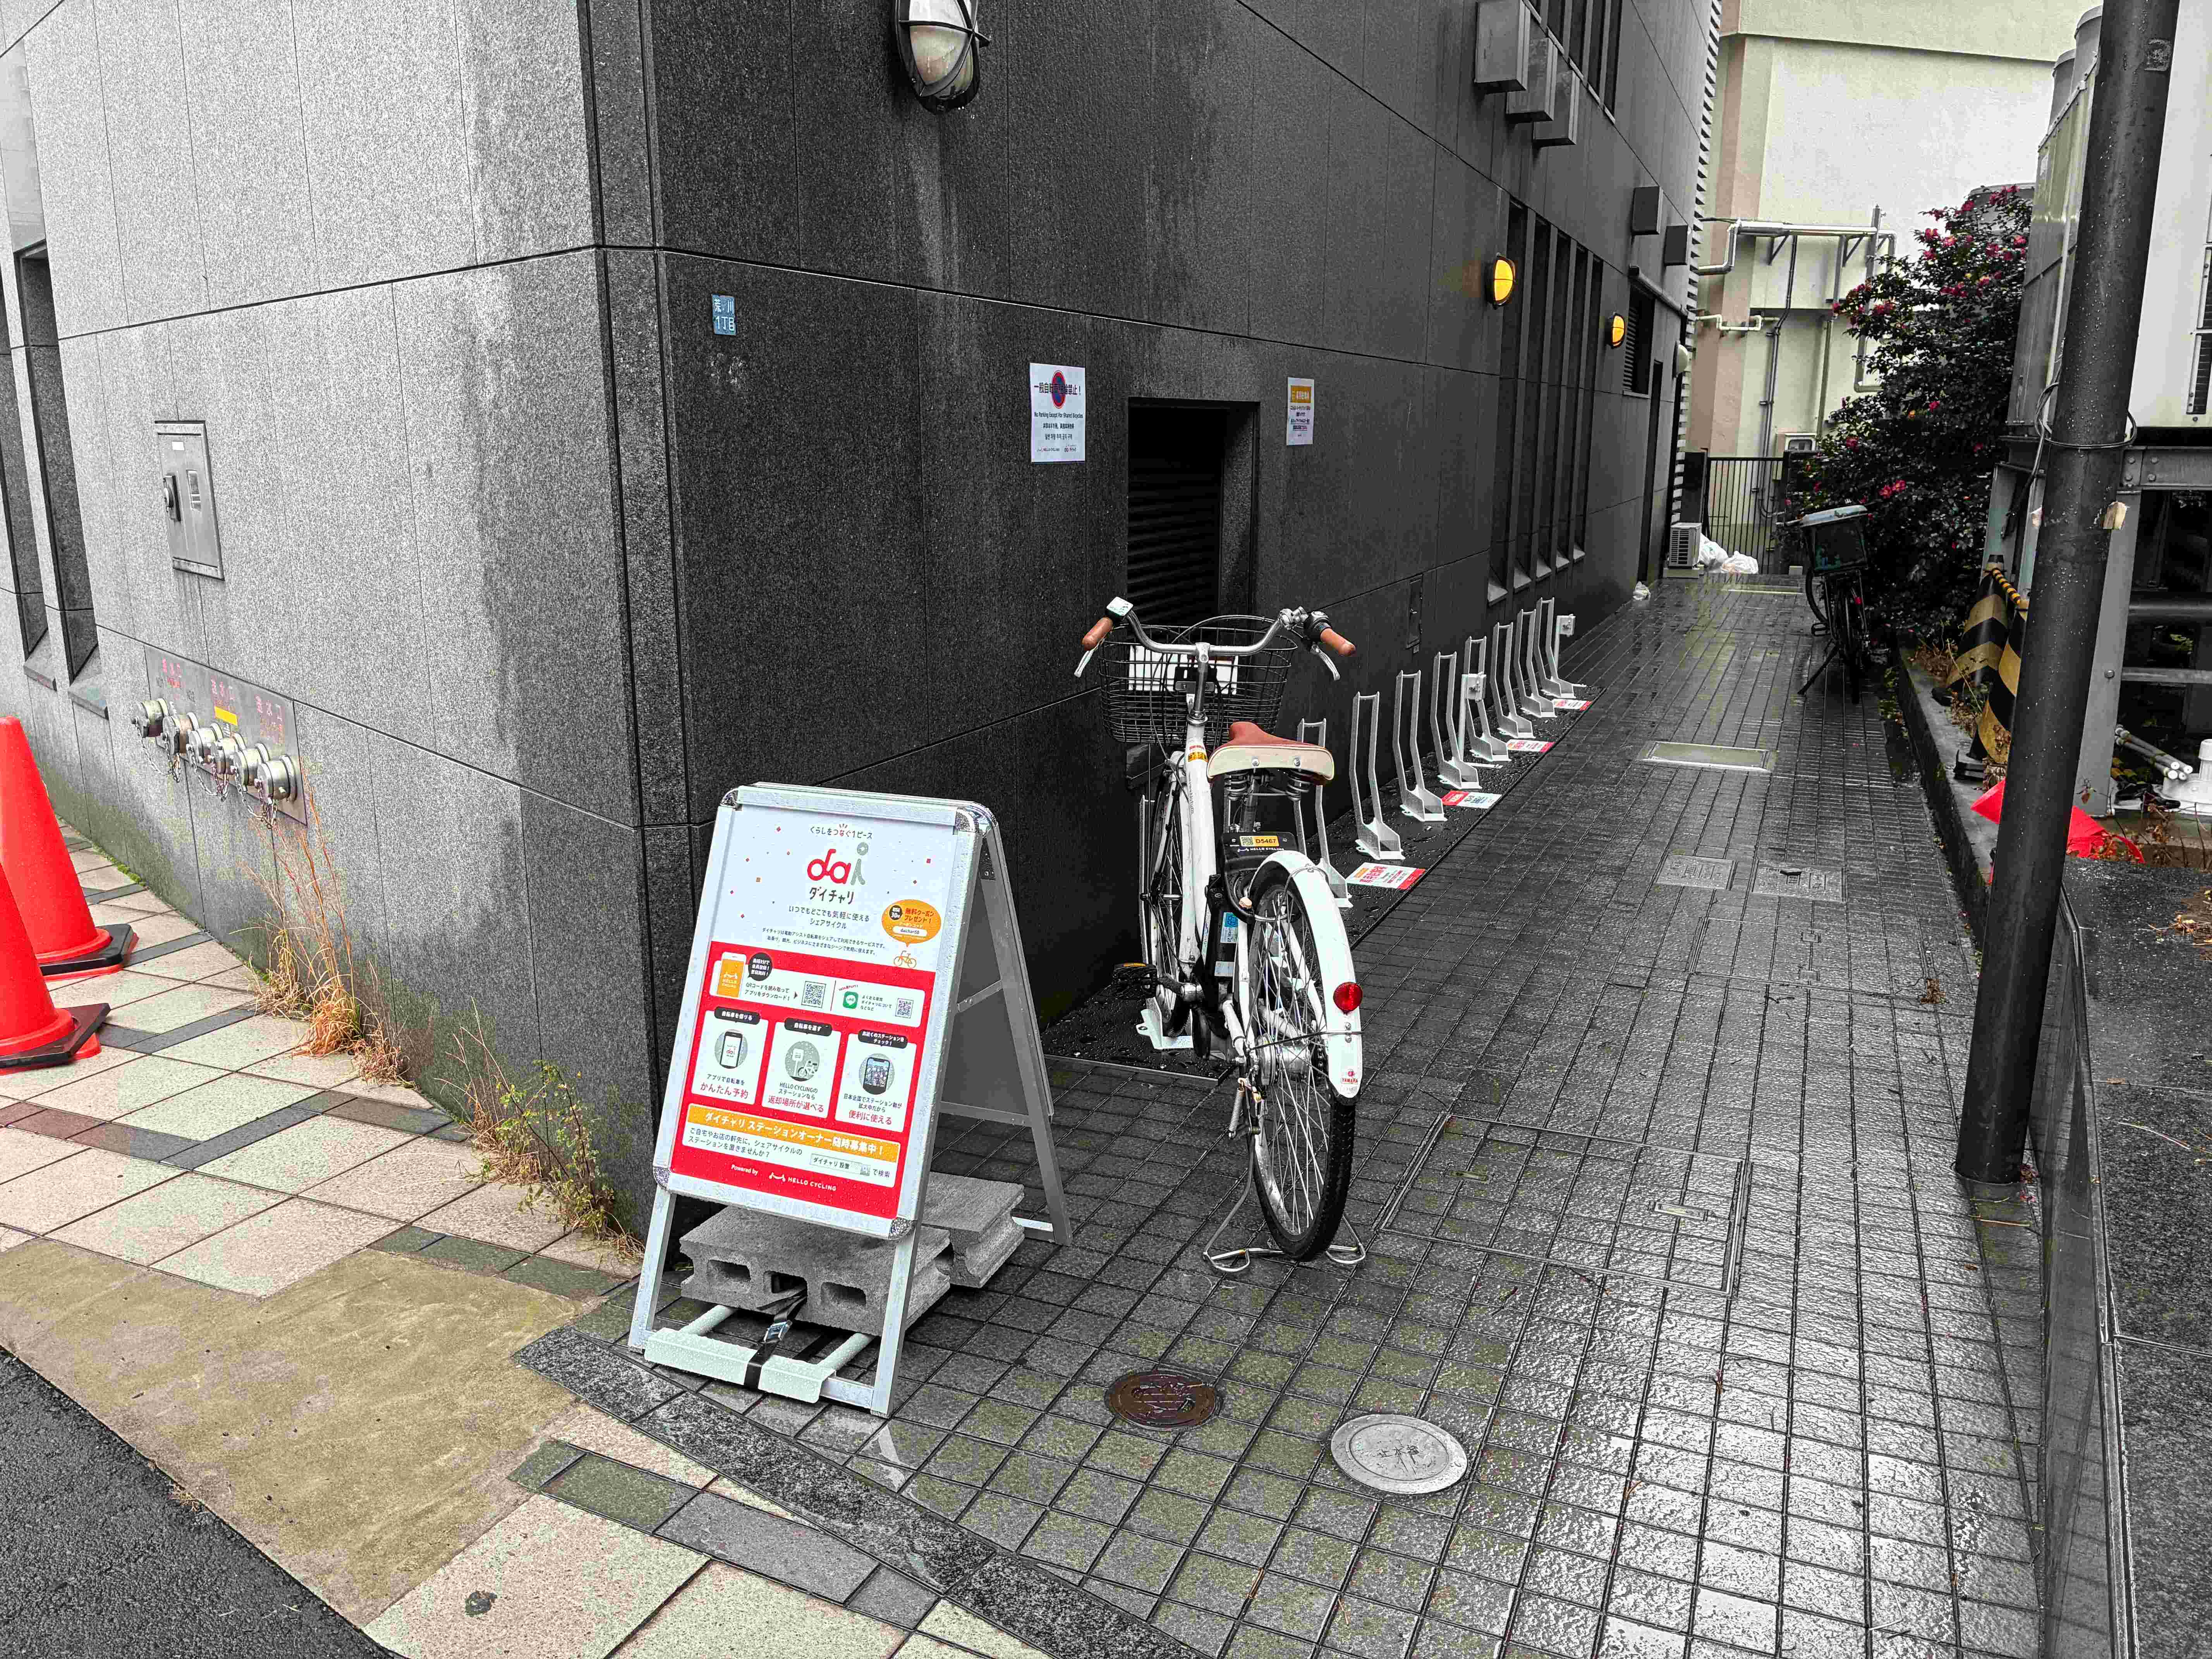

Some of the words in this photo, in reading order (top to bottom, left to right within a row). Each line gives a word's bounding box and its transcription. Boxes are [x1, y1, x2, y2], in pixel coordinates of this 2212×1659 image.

[716, 316, 735, 331] 1丁目
[811, 826, 872, 839] くらしをつなぐ1ピース
[807, 842, 869, 885] dai
[809, 886, 854, 904] ダイチャリ
[789, 905, 869, 922] いつでもどこでも気軽に使える
[905, 908, 934, 917] 無料クーポン
[810, 918, 847, 929] シェアサイクル
[746, 982, 790, 993] QRコードを読み取って
[707, 1073, 745, 1085] アプリで自転車を
[700, 1082, 749, 1099] かんたん予約
[778, 1089, 815, 1100] ステーションなら
[794, 1084, 817, 1093] CYCLINGの
[768, 1095, 824, 1113] 返却場所が選べる
[849, 1110, 891, 1125] 便利に使える
[688, 1136, 769, 1158] ステーションを置きませんか？
[690, 1128, 802, 1155] ご自宅やお店の軒先に、シェアサイクルの
[731, 1164, 751, 1173] Powered
[813, 1157, 838, 1167] ダイチャリ
[873, 1169, 890, 1178] で検索
[788, 1177, 808, 1186] HELLO
[810, 1181, 836, 1191] CYCLING
